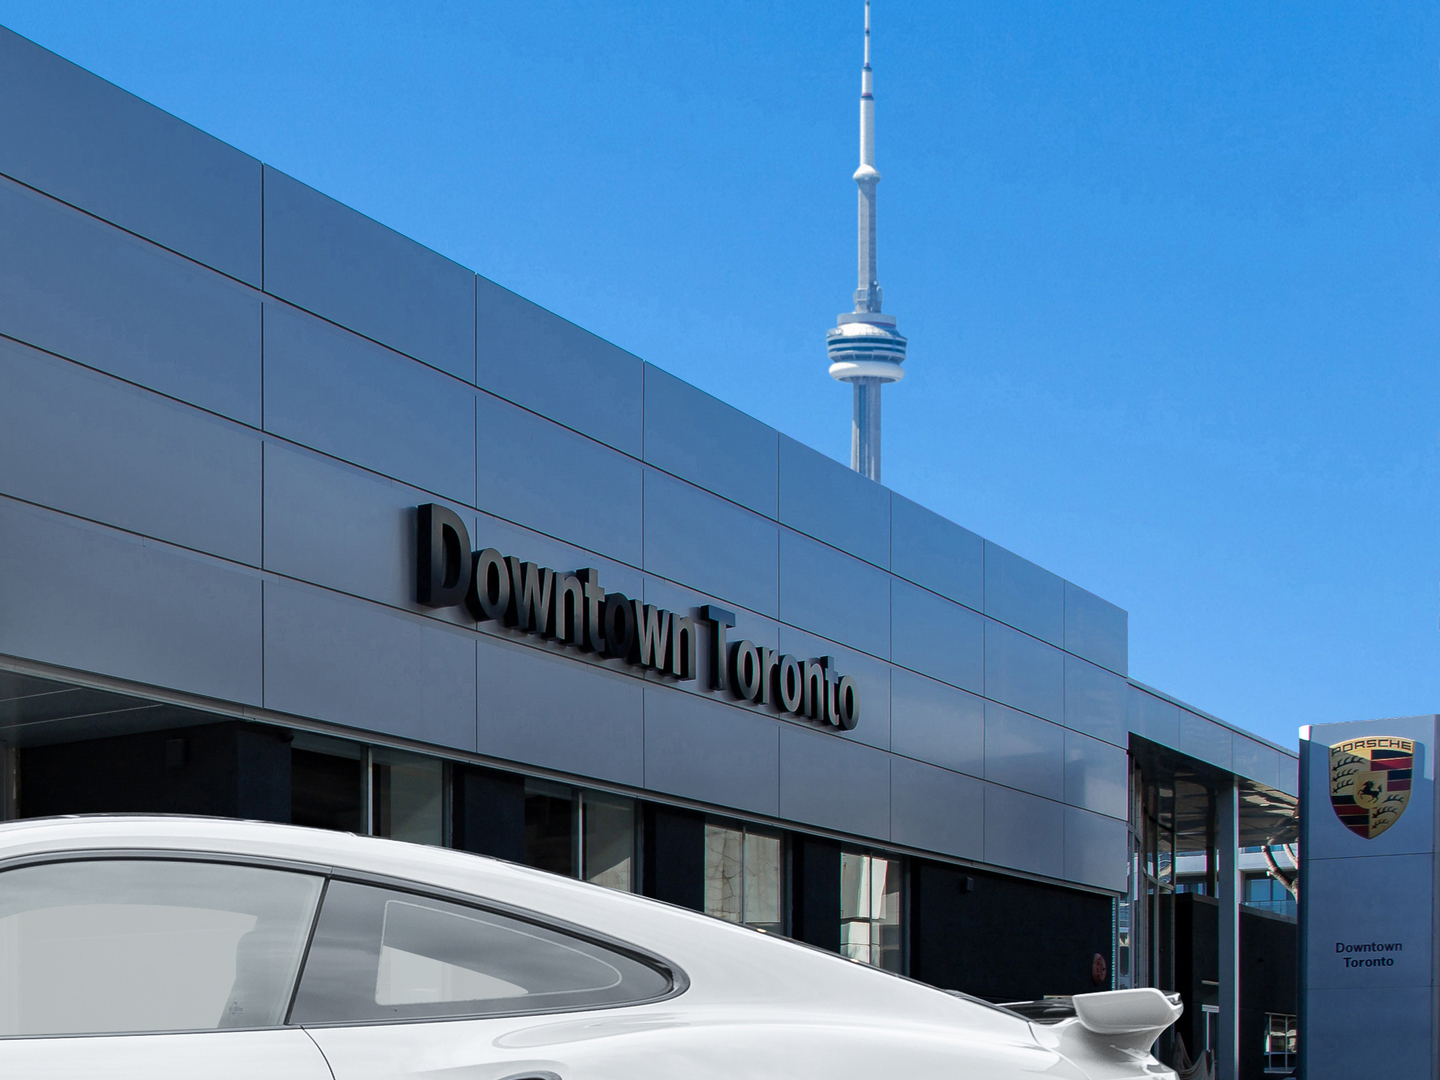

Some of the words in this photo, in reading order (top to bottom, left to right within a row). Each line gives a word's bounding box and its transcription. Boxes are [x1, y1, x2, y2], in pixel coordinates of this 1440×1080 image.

[417, 502, 696, 681] Downtown
[700, 604, 860, 731] Toronto
[1331, 739, 1412, 757] PORSCHE
[1335, 942, 1403, 953] Downtown
[1343, 957, 1395, 968] Toronto
